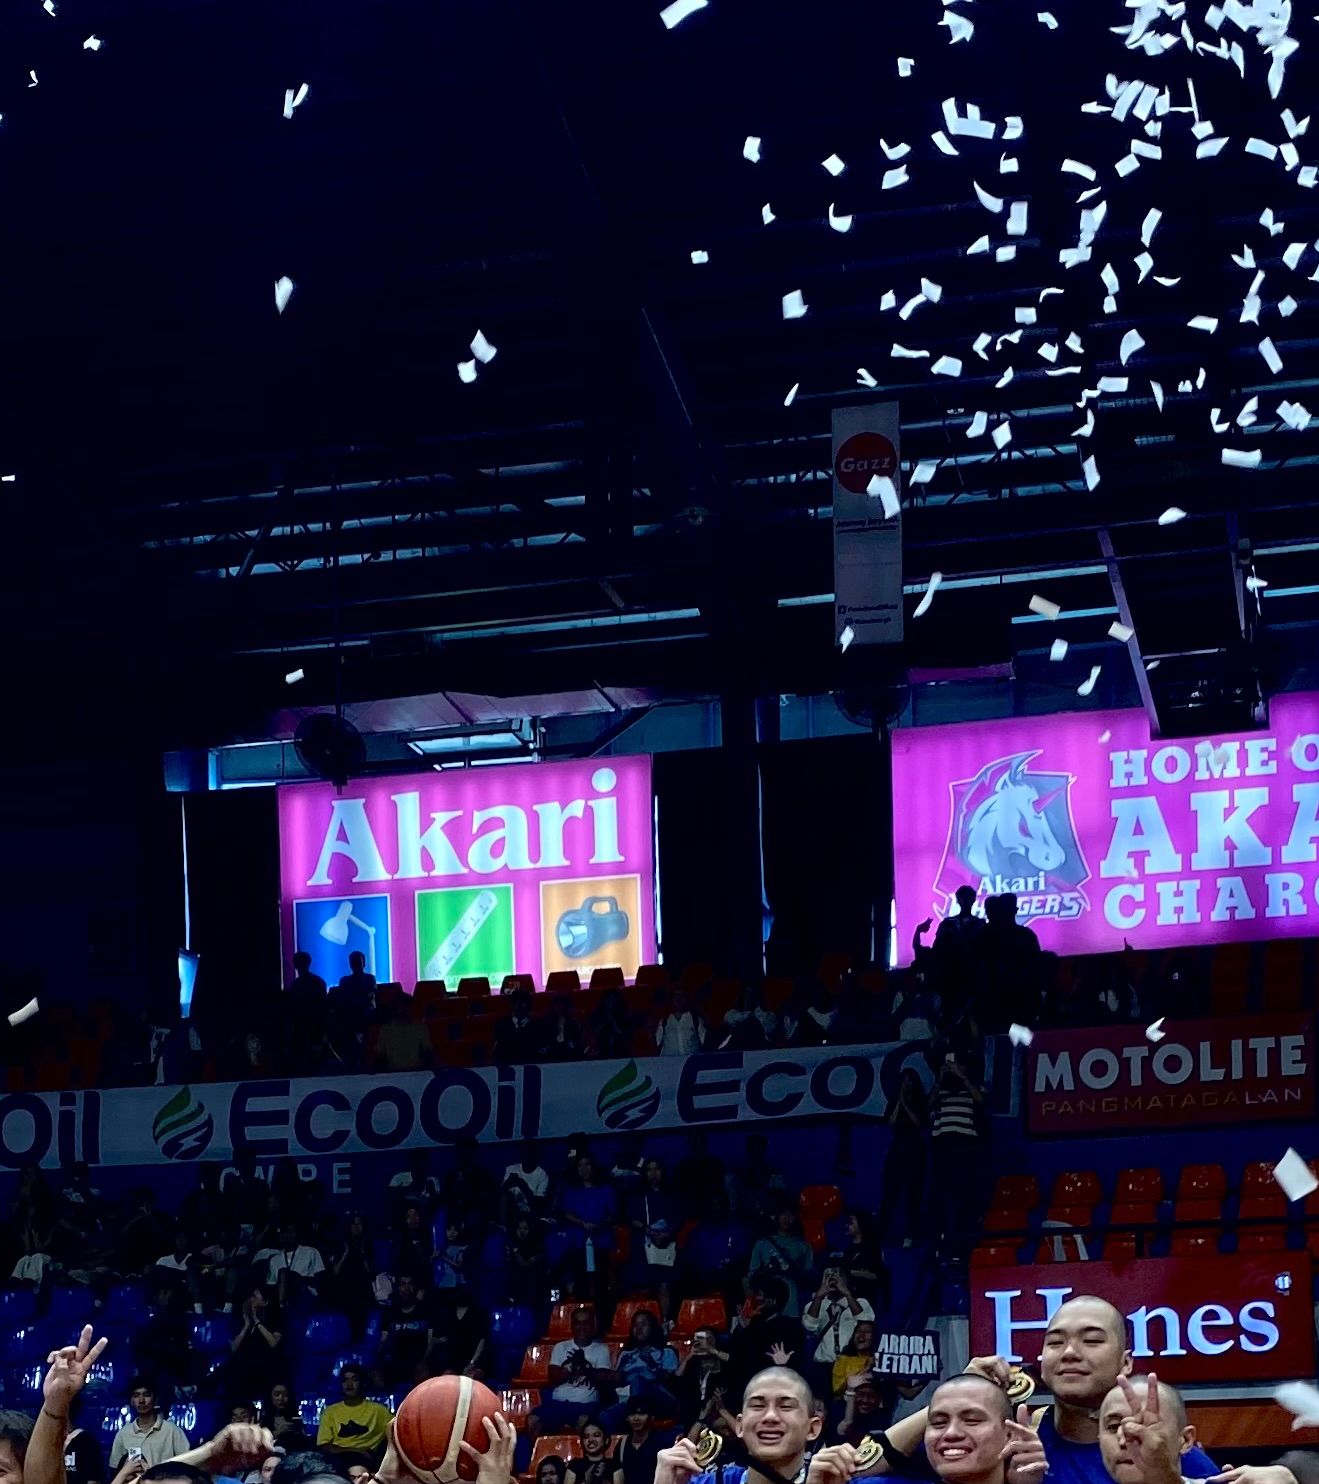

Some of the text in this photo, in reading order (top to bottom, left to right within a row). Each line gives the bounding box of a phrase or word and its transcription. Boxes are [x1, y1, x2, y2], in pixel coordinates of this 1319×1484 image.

[1109, 737, 1277, 788] HOME
[306, 767, 625, 886] Akari
[979, 871, 1046, 893] Akari
[1033, 1034, 1308, 1094] MOTOLITE
[231, 1066, 542, 1158] EcoOil
[878, 1333, 935, 1354] ARRIBA
[984, 1286, 1280, 1362] Hnes
